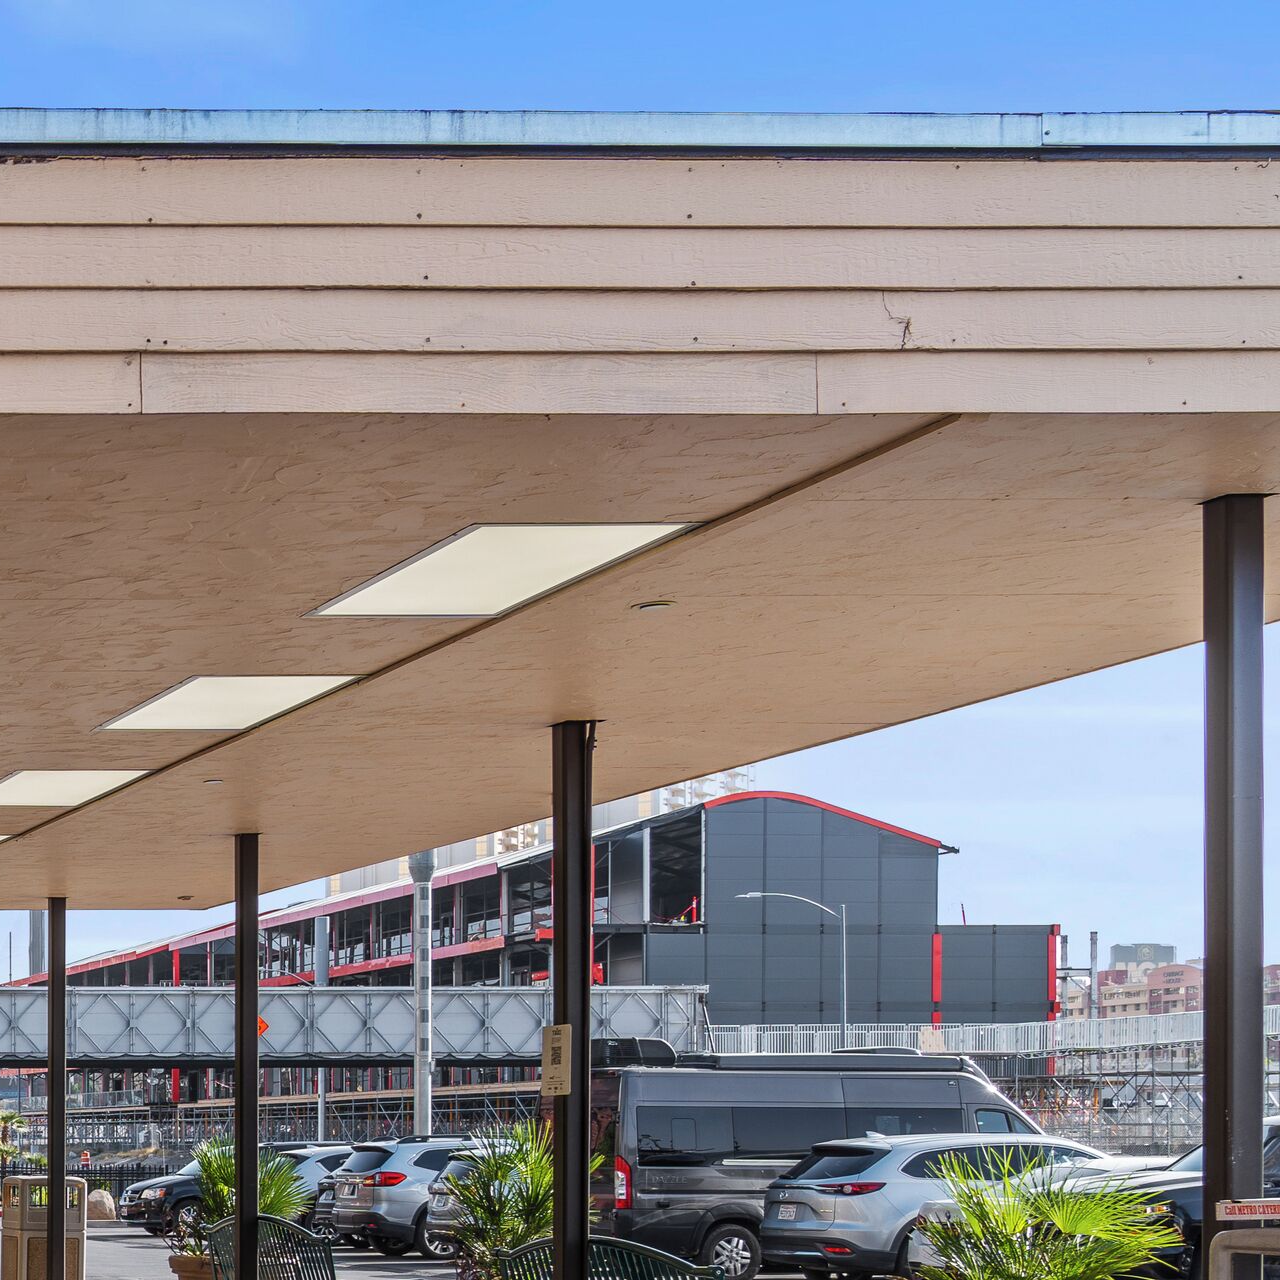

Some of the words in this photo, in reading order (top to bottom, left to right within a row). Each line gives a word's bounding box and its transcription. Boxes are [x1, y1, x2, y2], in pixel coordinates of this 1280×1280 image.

[651, 1175, 689, 1184] DAZZLE
[1224, 1205, 1237, 1215] Call
[1237, 1204, 1258, 1215] METRO
